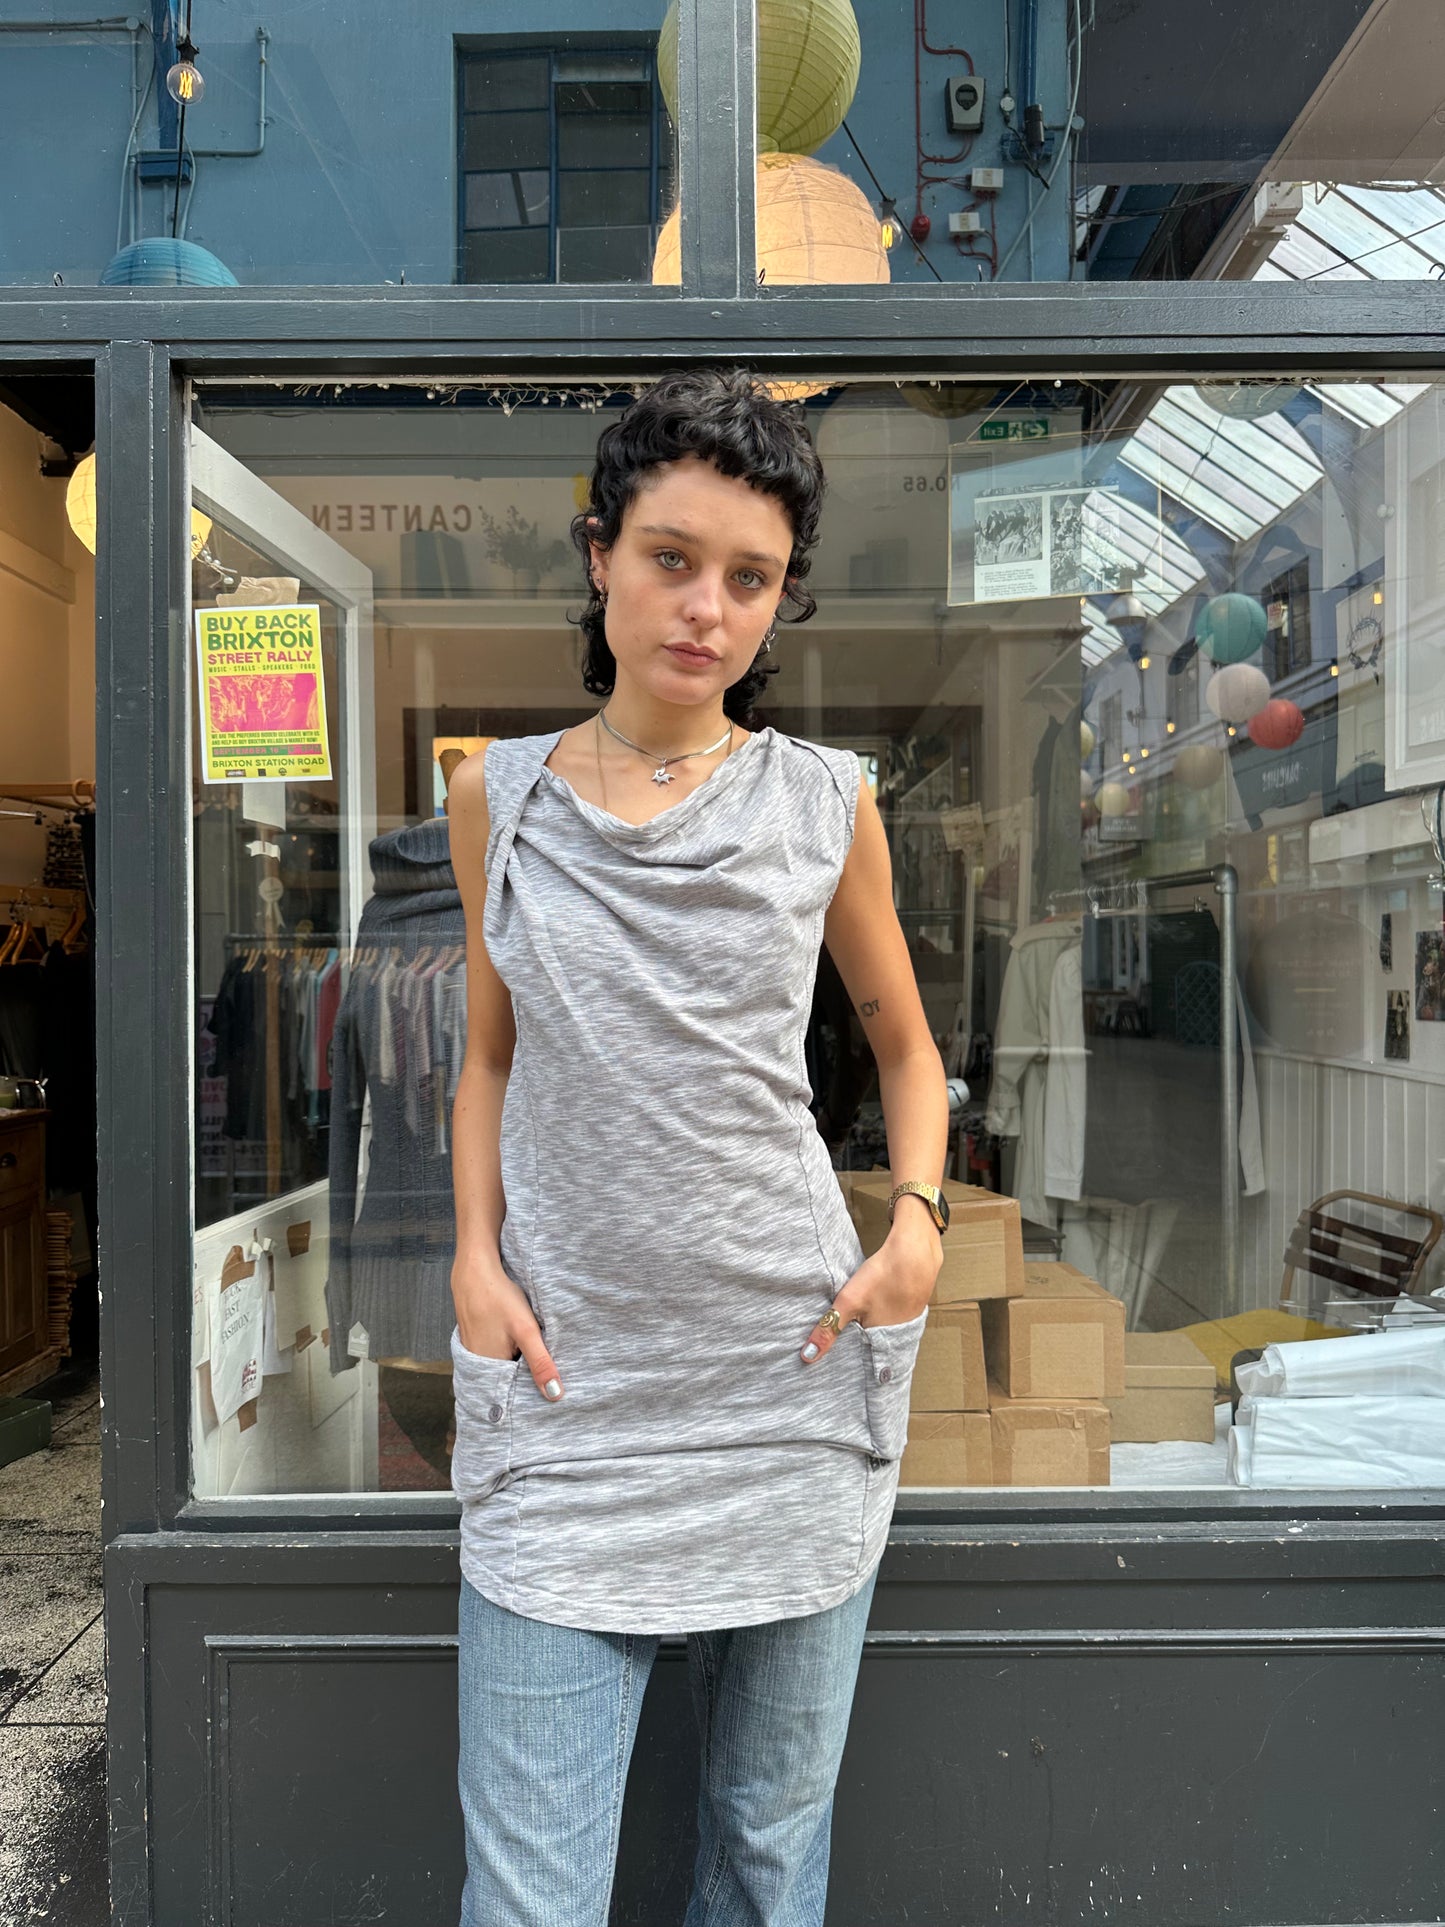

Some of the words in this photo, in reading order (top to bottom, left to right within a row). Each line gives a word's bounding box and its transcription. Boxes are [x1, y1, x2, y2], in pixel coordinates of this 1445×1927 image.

[206, 616, 248, 632] BUY
[256, 614, 312, 630] BACK
[208, 630, 314, 651] BRIXTON
[208, 652, 262, 665] STREET
[267, 650, 312, 663] RALLY
[212, 760, 252, 768] BRIXTON
[255, 758, 294, 767] STATION
[298, 757, 325, 766] ROAD
